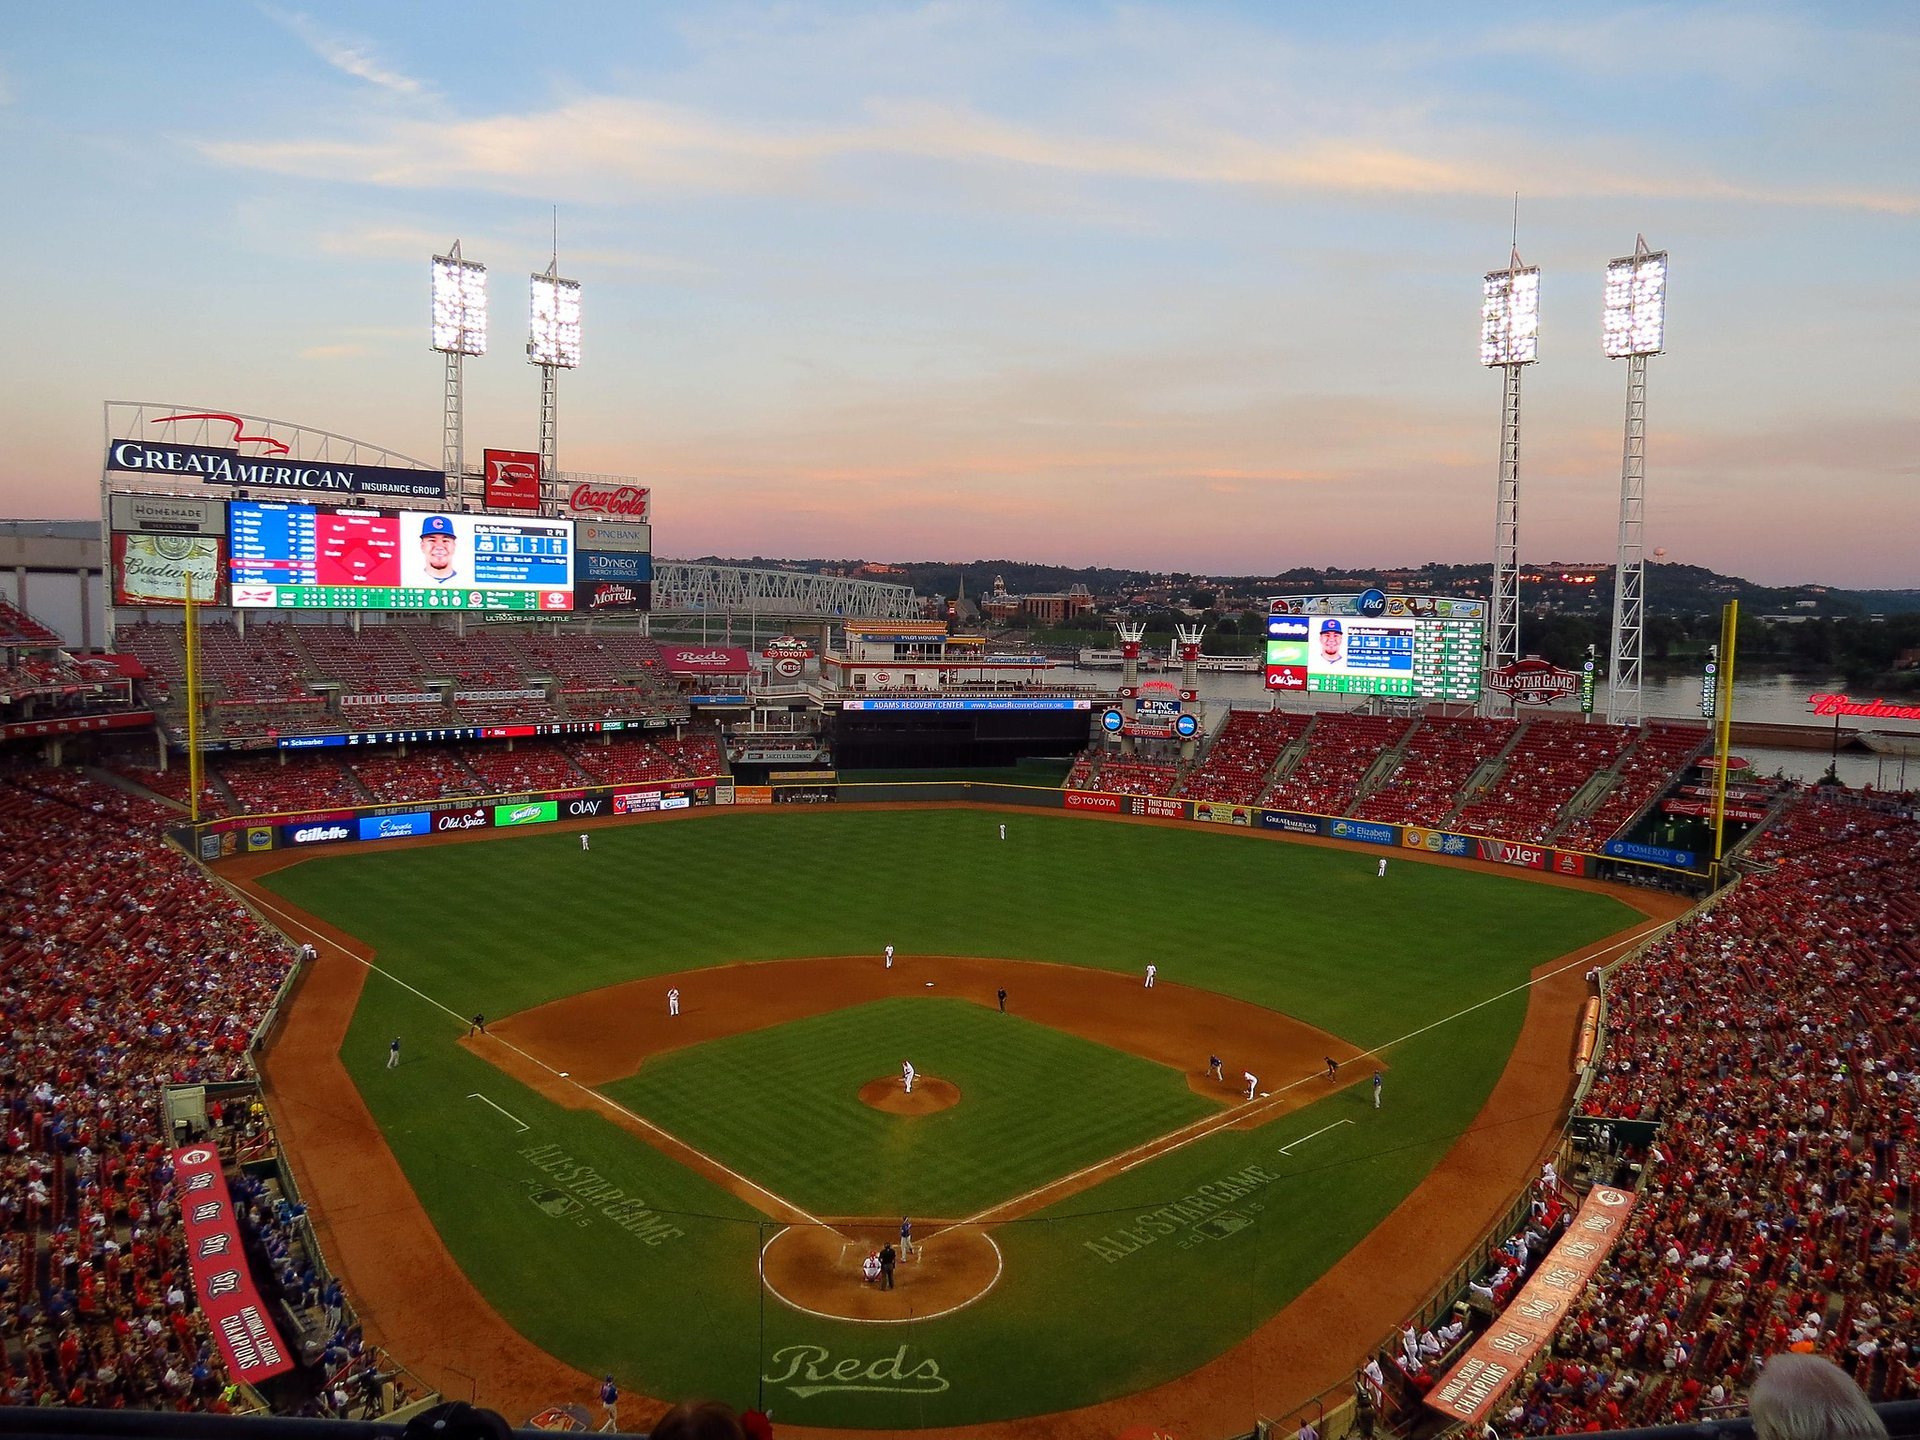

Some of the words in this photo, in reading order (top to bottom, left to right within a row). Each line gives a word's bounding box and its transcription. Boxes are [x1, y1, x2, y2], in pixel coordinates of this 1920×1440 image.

[115, 443, 226, 473] GREAT
[209, 458, 354, 489] AMERICAN
[361, 482, 411, 494] INSURANCE
[412, 486, 440, 495] GROUP
[569, 483, 650, 515] Coca-Cola
[136, 505, 202, 518] HOMEMADE
[599, 556, 638, 568] DYNEGY
[612, 569, 638, 577] SERVICES
[606, 584, 626, 594] John
[589, 587, 637, 608] Morrell
[1363, 600, 1383, 609] P&G
[676, 651, 730, 663] Reds
[985, 656, 1028, 664] Cincinnati
[1542, 673, 1573, 690] GAME
[1152, 702, 1173, 710] PNC
[1141, 728, 1163, 736] TOYOTA
[290, 738, 324, 746] Schwarber
[670, 781, 696, 789] NETWORK
[569, 799, 602, 815] OLAY
[1082, 796, 1116, 807] TOYOTA
[1147, 799, 1162, 807] THIS
[1163, 800, 1182, 809] BUD'S
[374, 807, 386, 816] FOR
[386, 806, 408, 815] SAFETY
[510, 805, 541, 822] Swiffer
[1147, 807, 1160, 815] FOR
[1160, 808, 1176, 816] YOU.
[1748, 811, 1763, 819] YOU.
[438, 816, 460, 830] Old
[459, 814, 486, 829] Spice
[1265, 815, 1288, 824] GREAT
[294, 827, 348, 843] Gillette
[379, 828, 412, 838] shoulders
[1356, 826, 1391, 838] Elizabeth
[1627, 844, 1671, 857] POMEROY
[1197, 1164, 1281, 1202] GAME
[601, 1198, 685, 1246] GAME
[202, 1234, 227, 1255] 1970
[212, 1271, 238, 1294] 1972
[1520, 1298, 1555, 1320] 1940
[240, 1305, 260, 1338] NATIONAL
[255, 1334, 282, 1367] LEAGUE
[1493, 1331, 1529, 1353] 1919
[219, 1315, 261, 1371] CHAMPIONS
[762, 1344, 950, 1397] Reds
[1437, 1374, 1467, 1402] WORLD
[1457, 1357, 1486, 1382] SERIES
[1453, 1362, 1508, 1416] CHAMPIONS
